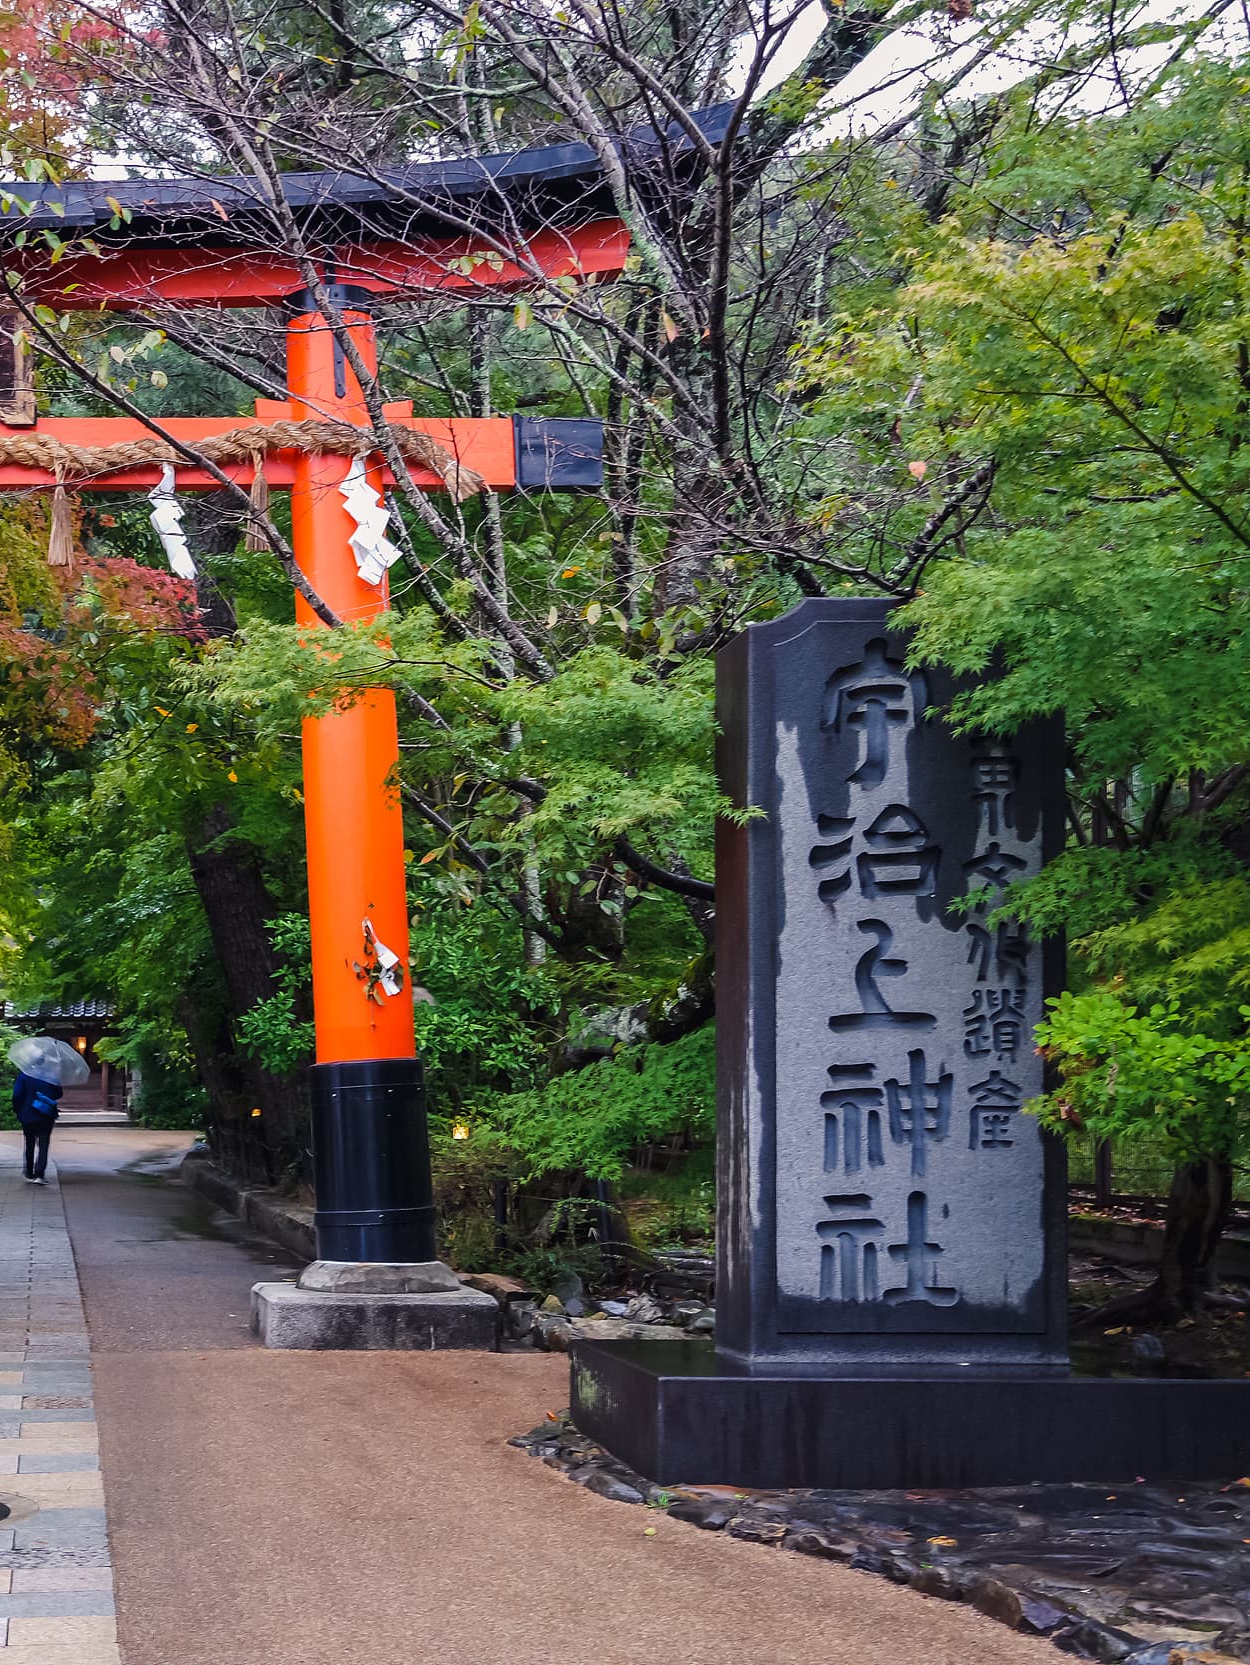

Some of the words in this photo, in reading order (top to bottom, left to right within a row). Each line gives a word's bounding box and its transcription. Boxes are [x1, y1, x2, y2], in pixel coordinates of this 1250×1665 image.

[808, 636, 961, 1306] 宇治上神社
[961, 733, 1033, 1150] 界文化遺産
